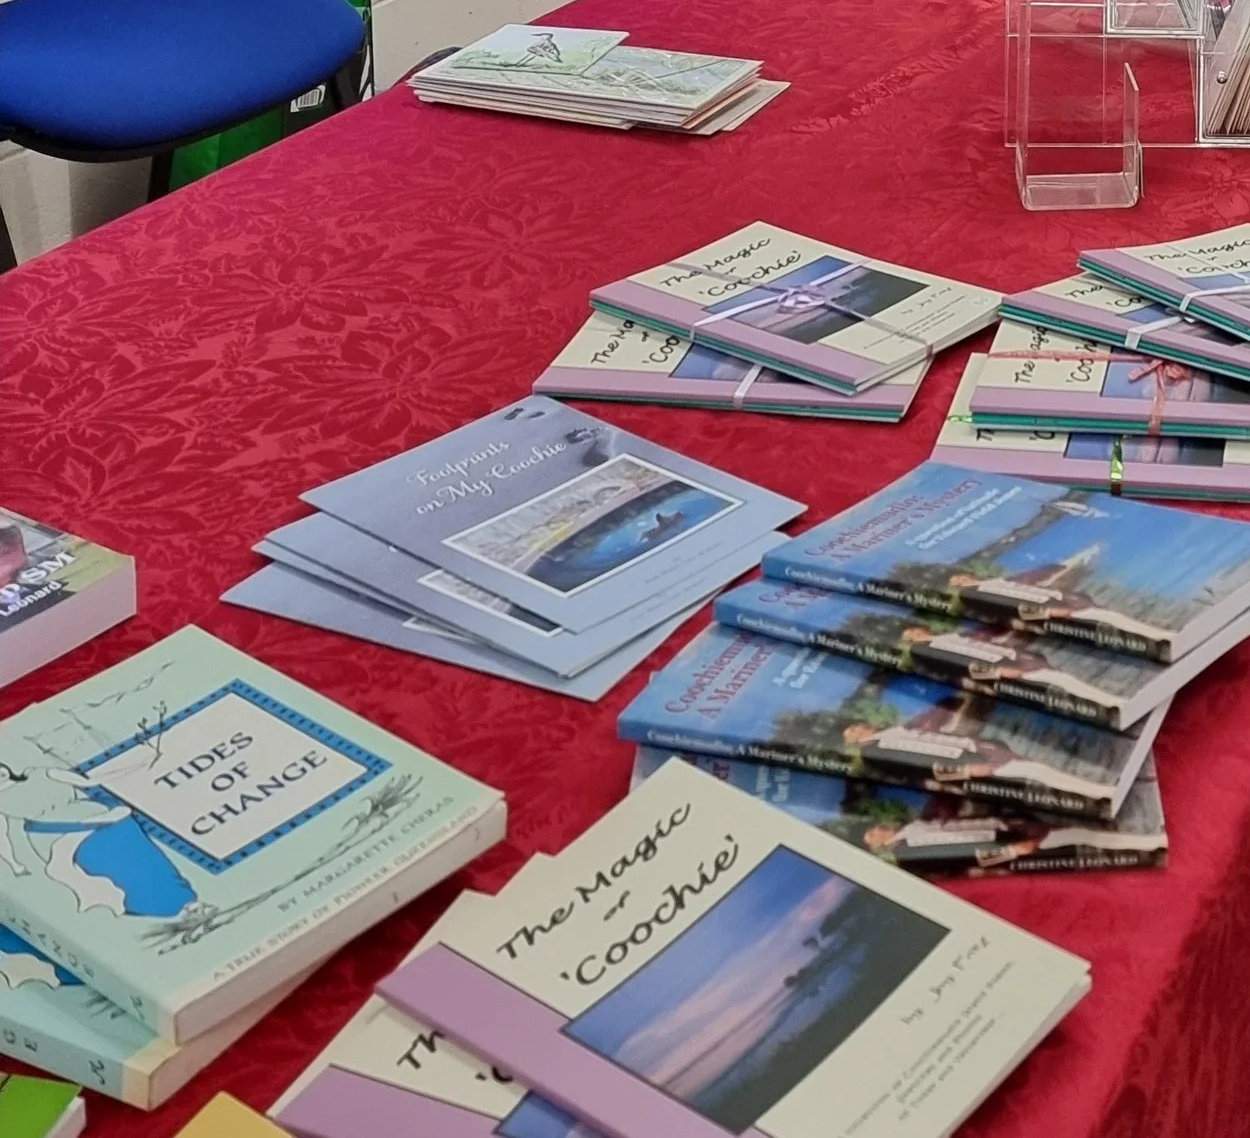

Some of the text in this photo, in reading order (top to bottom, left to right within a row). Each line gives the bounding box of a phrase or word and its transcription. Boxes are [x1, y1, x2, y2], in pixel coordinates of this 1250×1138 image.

[702, 238, 771, 271] Magic
[591, 338, 620, 365] The
[406, 440, 511, 487] Footprints
[415, 442, 567, 515] on My Coochie
[916, 477, 983, 514] Mystery
[0, 580, 62, 616] Leonard
[866, 583, 912, 603] Mariner's
[913, 592, 953, 614] Mystery
[817, 634, 863, 655] Mariner's
[863, 643, 905, 667] Mystery
[153, 731, 254, 790] TIDES
[210, 760, 251, 792] OF
[190, 749, 328, 836] CHANGE
[963, 780, 1085, 811] CHRISTINE LEONARD
[496, 802, 691, 960] The Magic
[278, 896, 298, 913] BY
[560, 833, 739, 986] 'Coochie'
[266, 917, 310, 948] STORY
[311, 904, 330, 920] OF
[397, 1030, 447, 1070] Th
